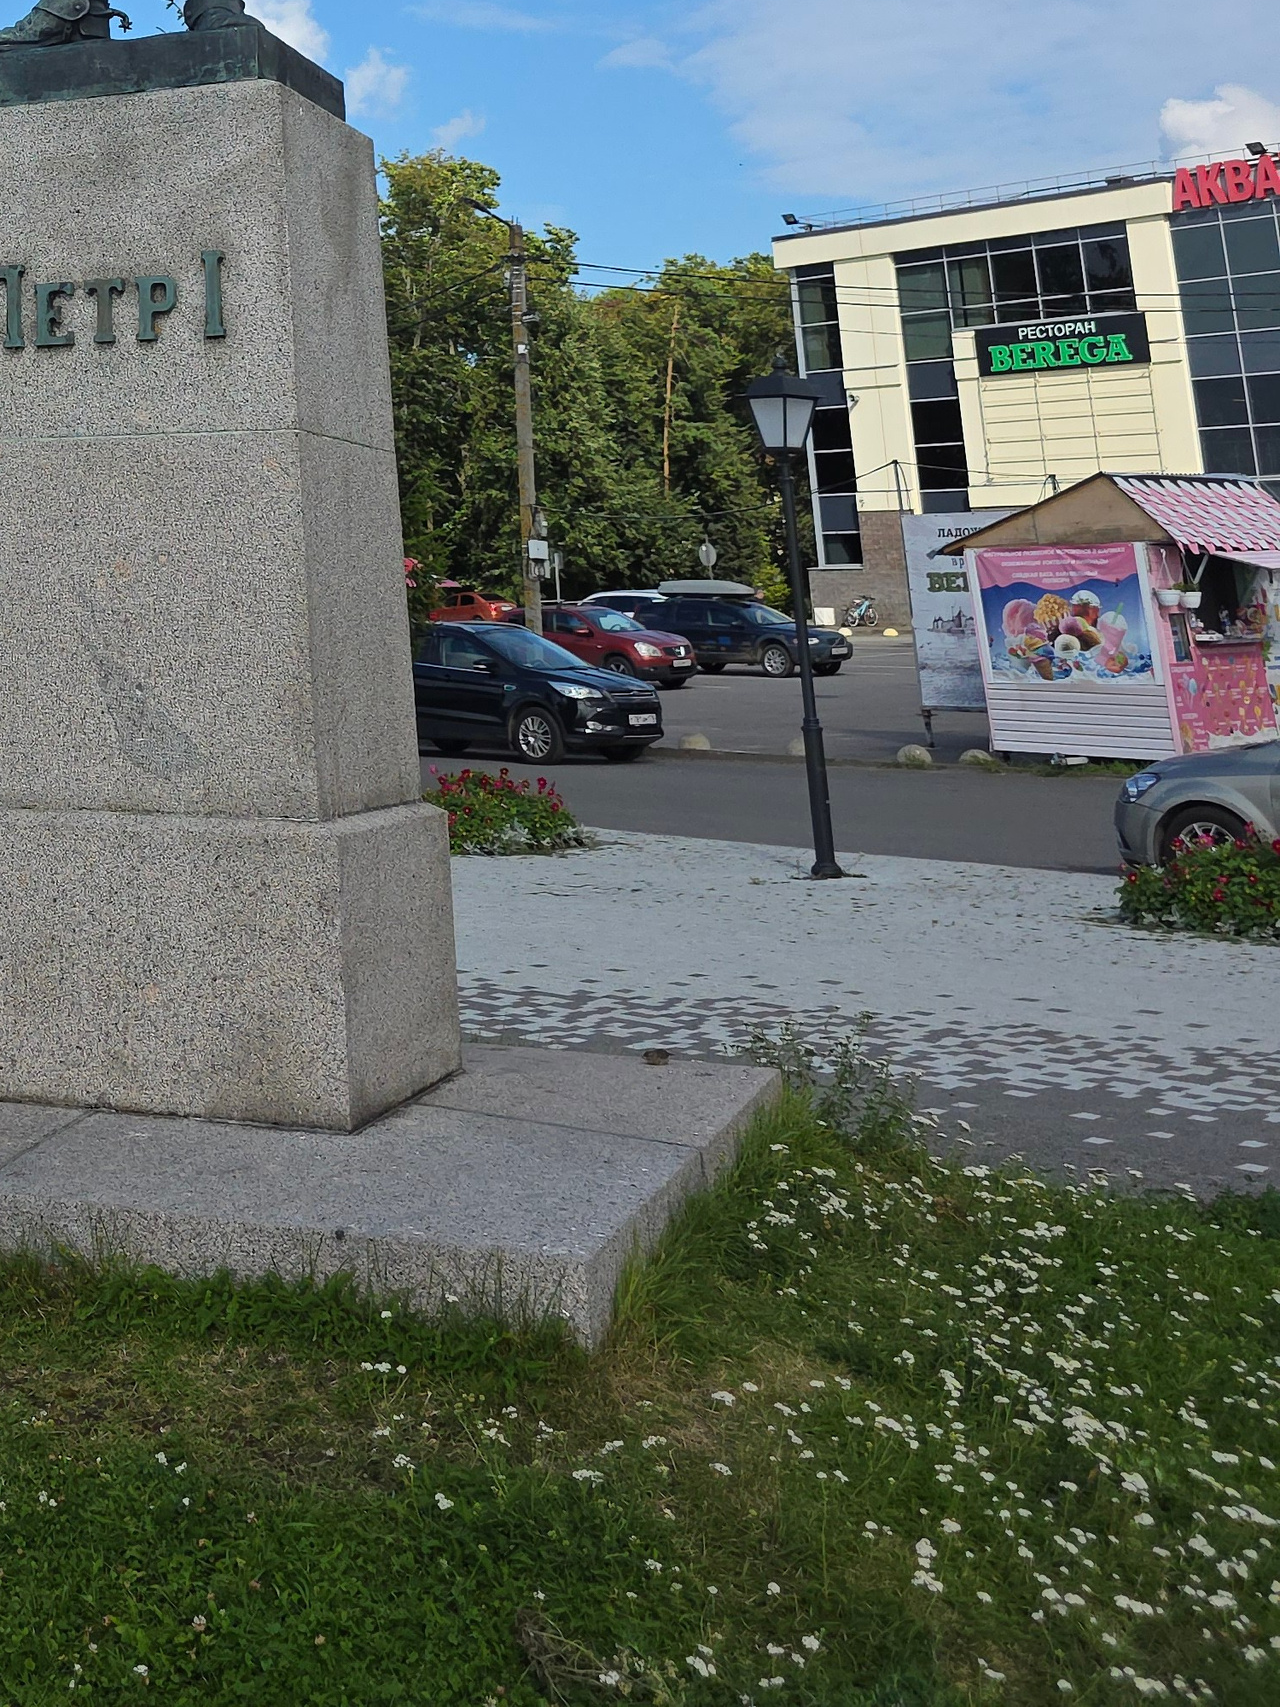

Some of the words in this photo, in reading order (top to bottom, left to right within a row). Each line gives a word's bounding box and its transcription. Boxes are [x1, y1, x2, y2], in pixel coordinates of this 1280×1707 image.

[1173, 152, 1280, 211] АКВА
[1017, 320, 1097, 341] РЕСТОРАН
[987, 333, 1134, 373] BEREGA
